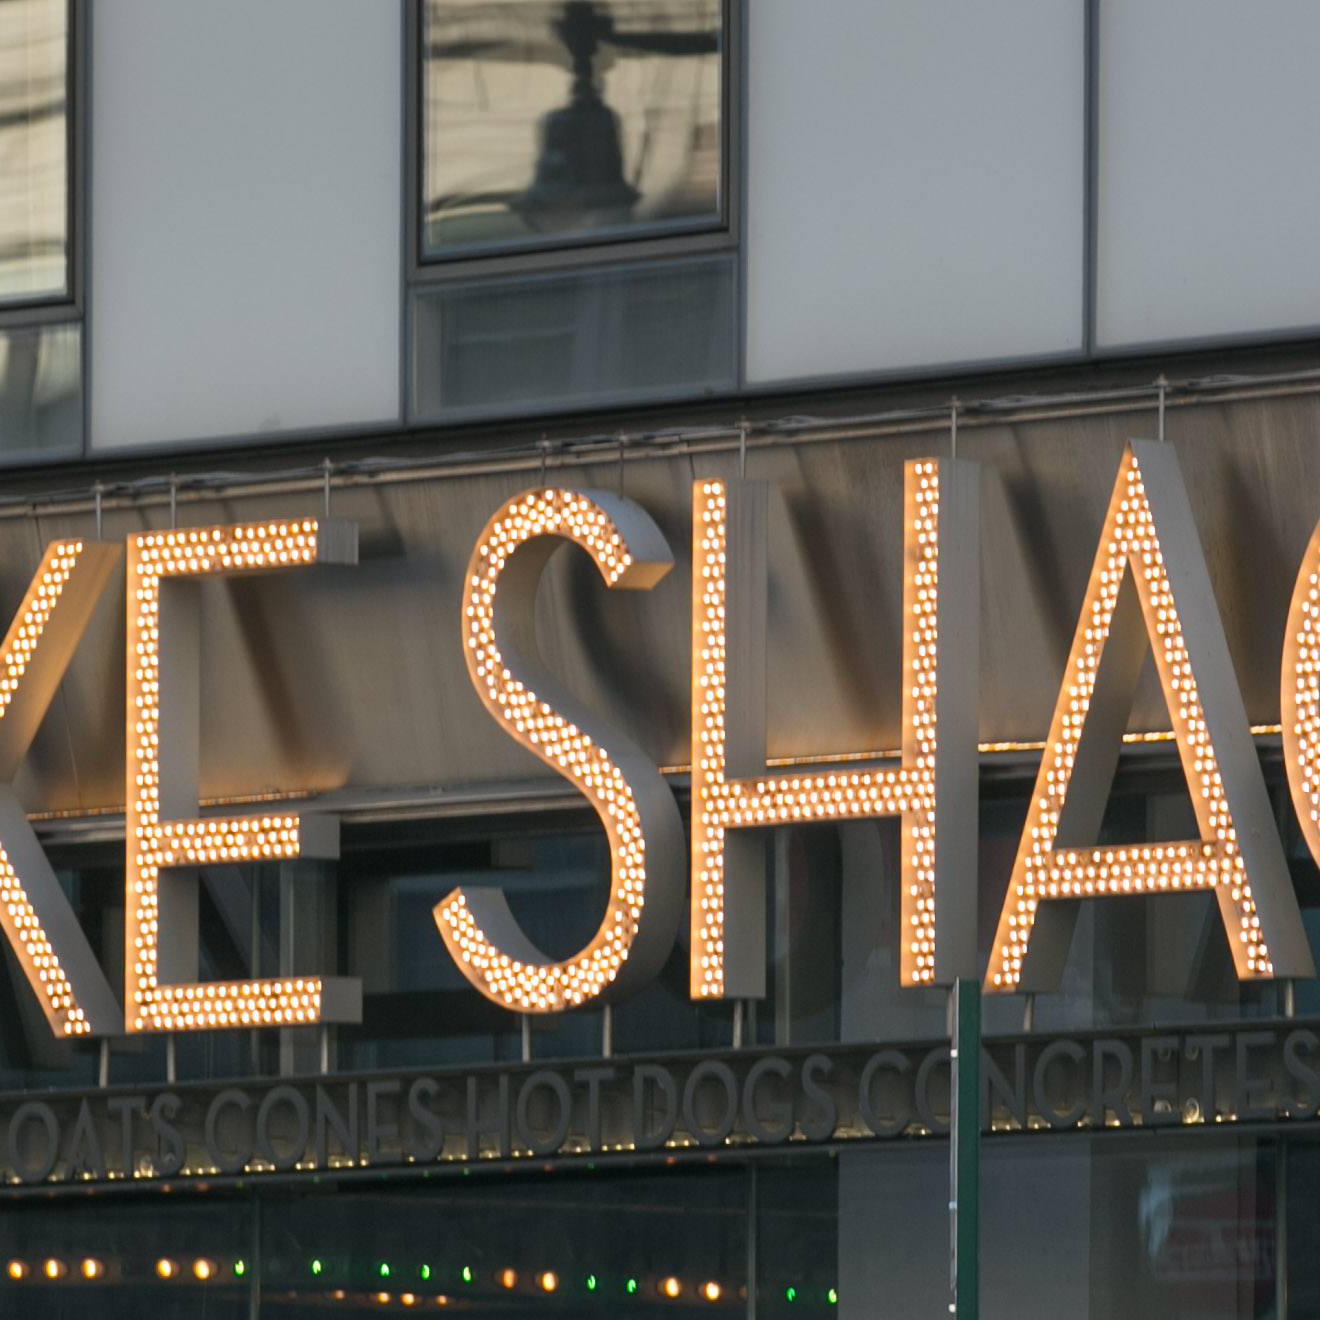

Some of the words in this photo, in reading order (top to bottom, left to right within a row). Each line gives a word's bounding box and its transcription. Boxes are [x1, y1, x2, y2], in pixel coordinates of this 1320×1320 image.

[204, 1075, 446, 1173] CONES
[467, 1066, 615, 1158] HOT
[633, 1052, 839, 1149] DOGS
